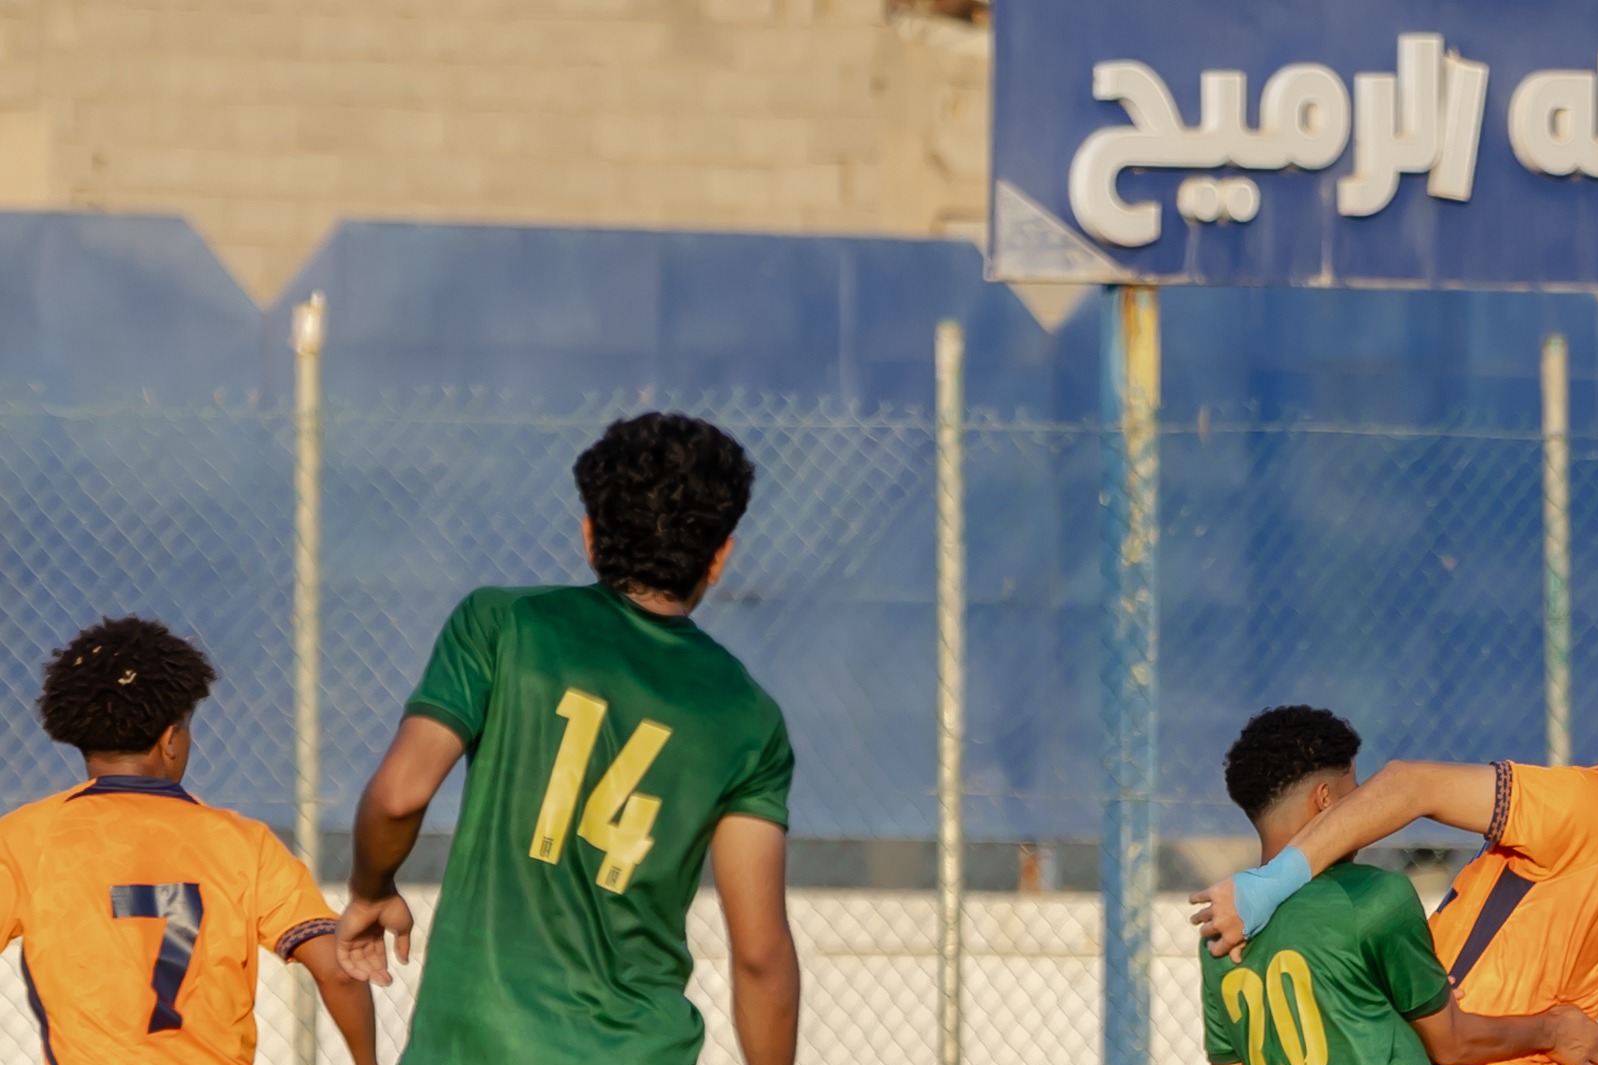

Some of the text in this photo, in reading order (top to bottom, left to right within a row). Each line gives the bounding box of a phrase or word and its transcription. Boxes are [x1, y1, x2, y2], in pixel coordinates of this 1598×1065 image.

[1069, 33, 1489, 247] الرميح
[529, 687, 673, 895] 14
[109, 882, 204, 1034] 7
